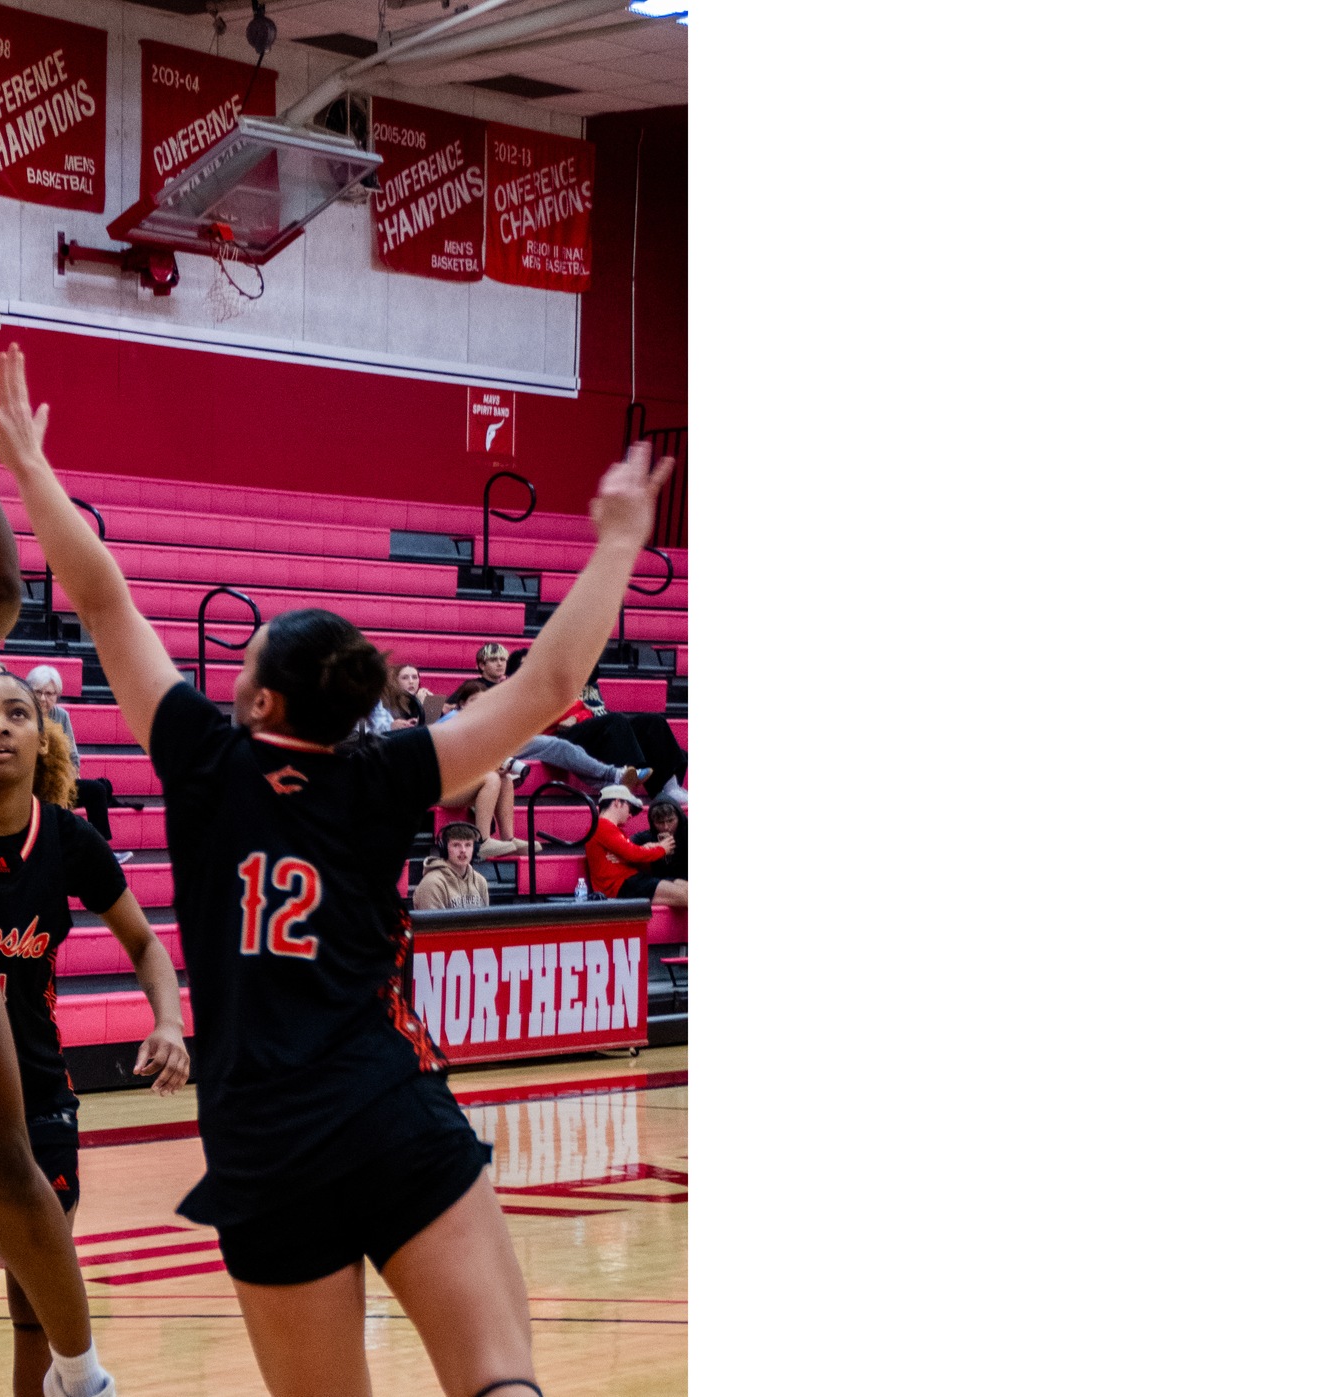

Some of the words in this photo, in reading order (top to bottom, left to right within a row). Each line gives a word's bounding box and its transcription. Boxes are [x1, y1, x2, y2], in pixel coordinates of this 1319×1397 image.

[152, 64, 200, 94] 2003-04
[153, 94, 242, 176] CONFERENCE
[374, 123, 426, 150] 2005-2006
[26, 167, 93, 195] BASKETBALL
[375, 140, 463, 212] CONFERENCE
[444, 240, 473, 256] MEN'S
[473, 404, 492, 416] SPIRIT
[483, 394, 500, 406] MAVS
[238, 851, 322, 960] 12
[413, 937, 641, 1046] NORTHERN
